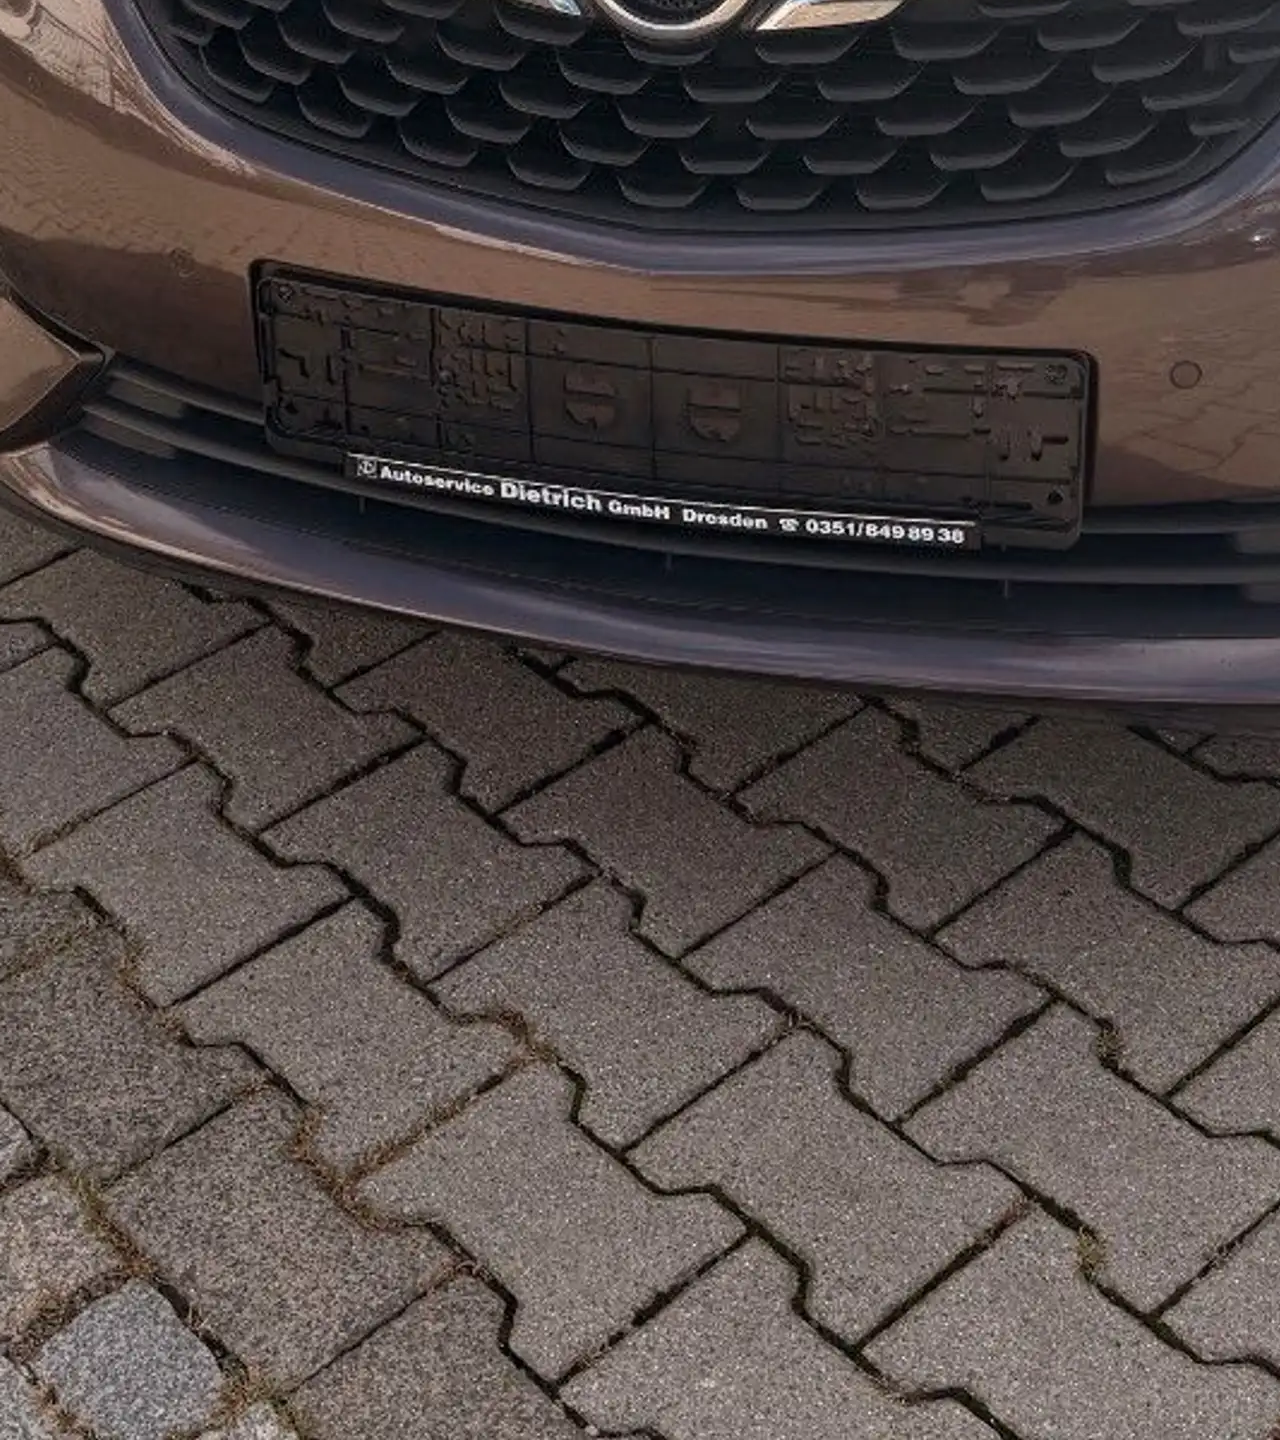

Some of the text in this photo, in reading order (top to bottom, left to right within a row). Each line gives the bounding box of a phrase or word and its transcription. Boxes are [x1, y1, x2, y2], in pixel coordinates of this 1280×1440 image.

[379, 465, 495, 496] Autoservice
[500, 481, 602, 512] Dietrich
[608, 496, 671, 520] GmbH
[682, 507, 769, 530] Dresden
